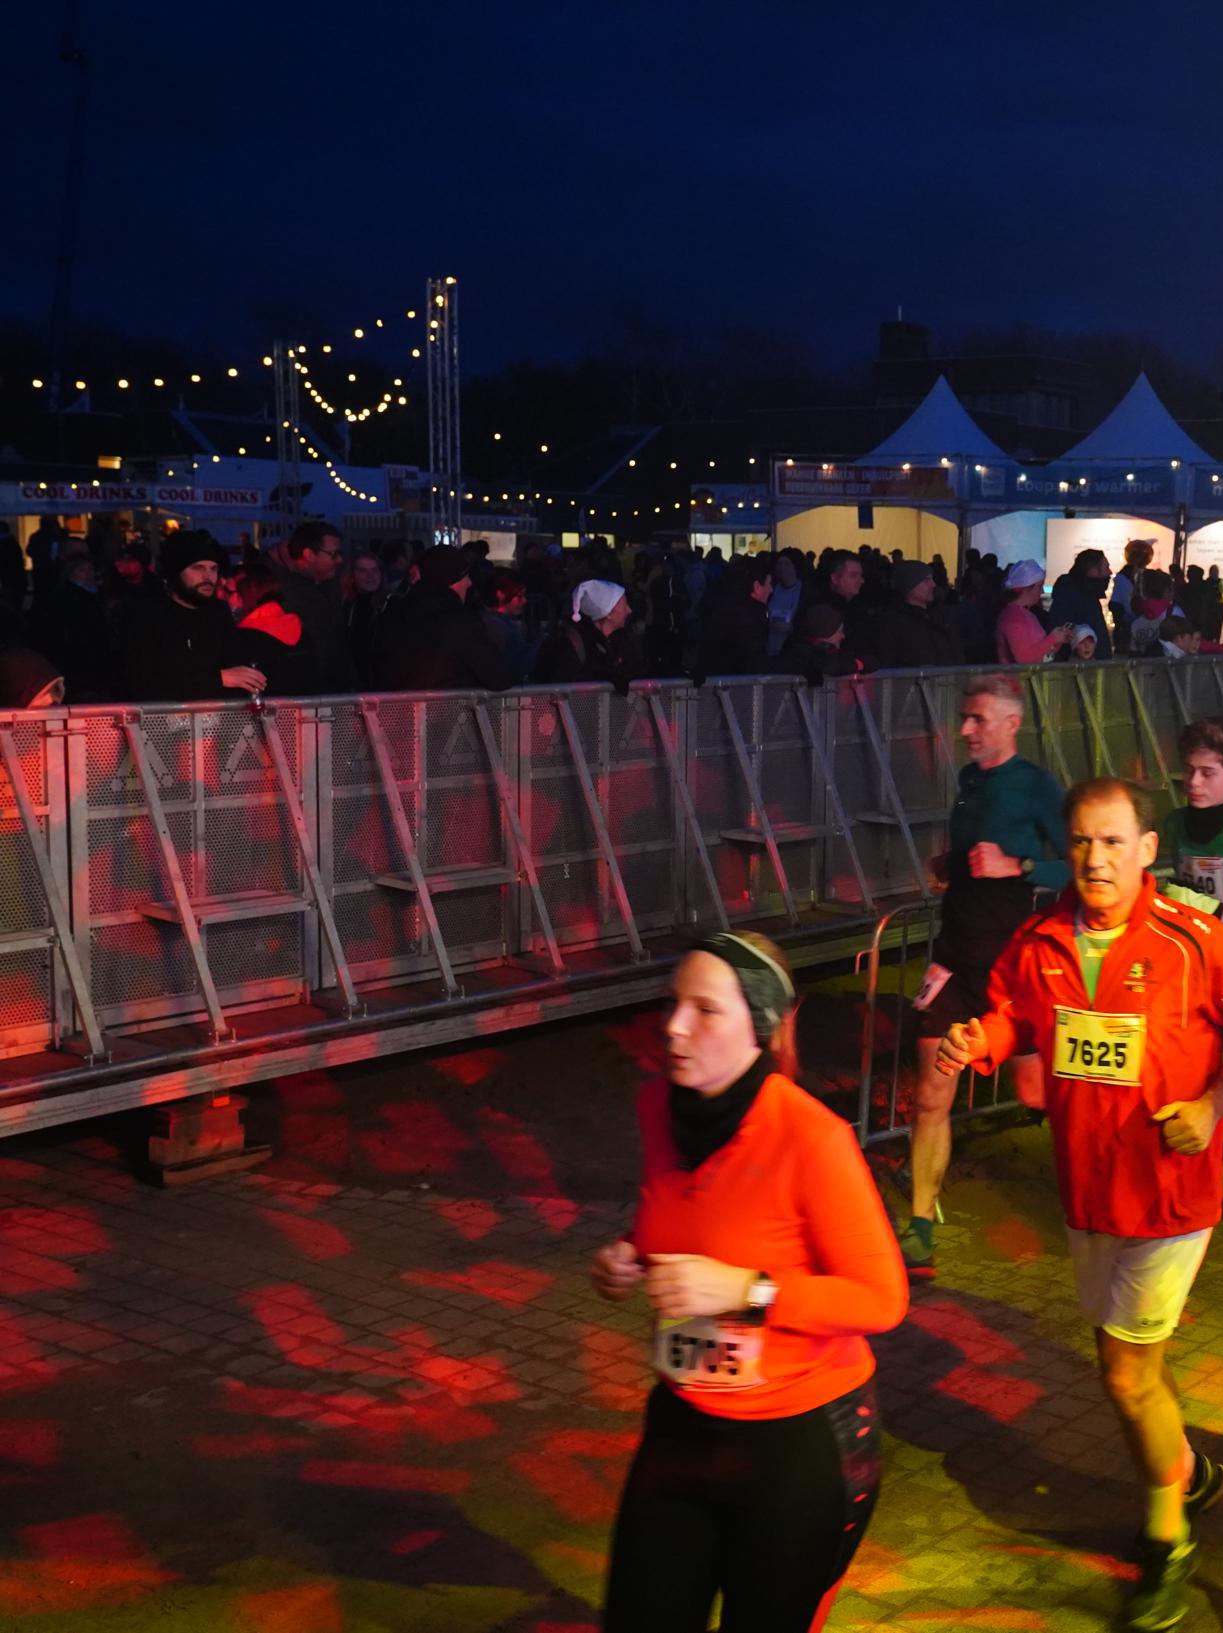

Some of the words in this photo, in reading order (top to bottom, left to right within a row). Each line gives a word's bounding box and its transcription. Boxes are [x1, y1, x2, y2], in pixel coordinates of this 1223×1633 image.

[22, 486, 66, 501] COOL
[77, 485, 146, 501] DRINKS
[158, 488, 199, 502] COOL
[203, 488, 258, 504] DRINKS
[1067, 1037, 1128, 1069] 7625
